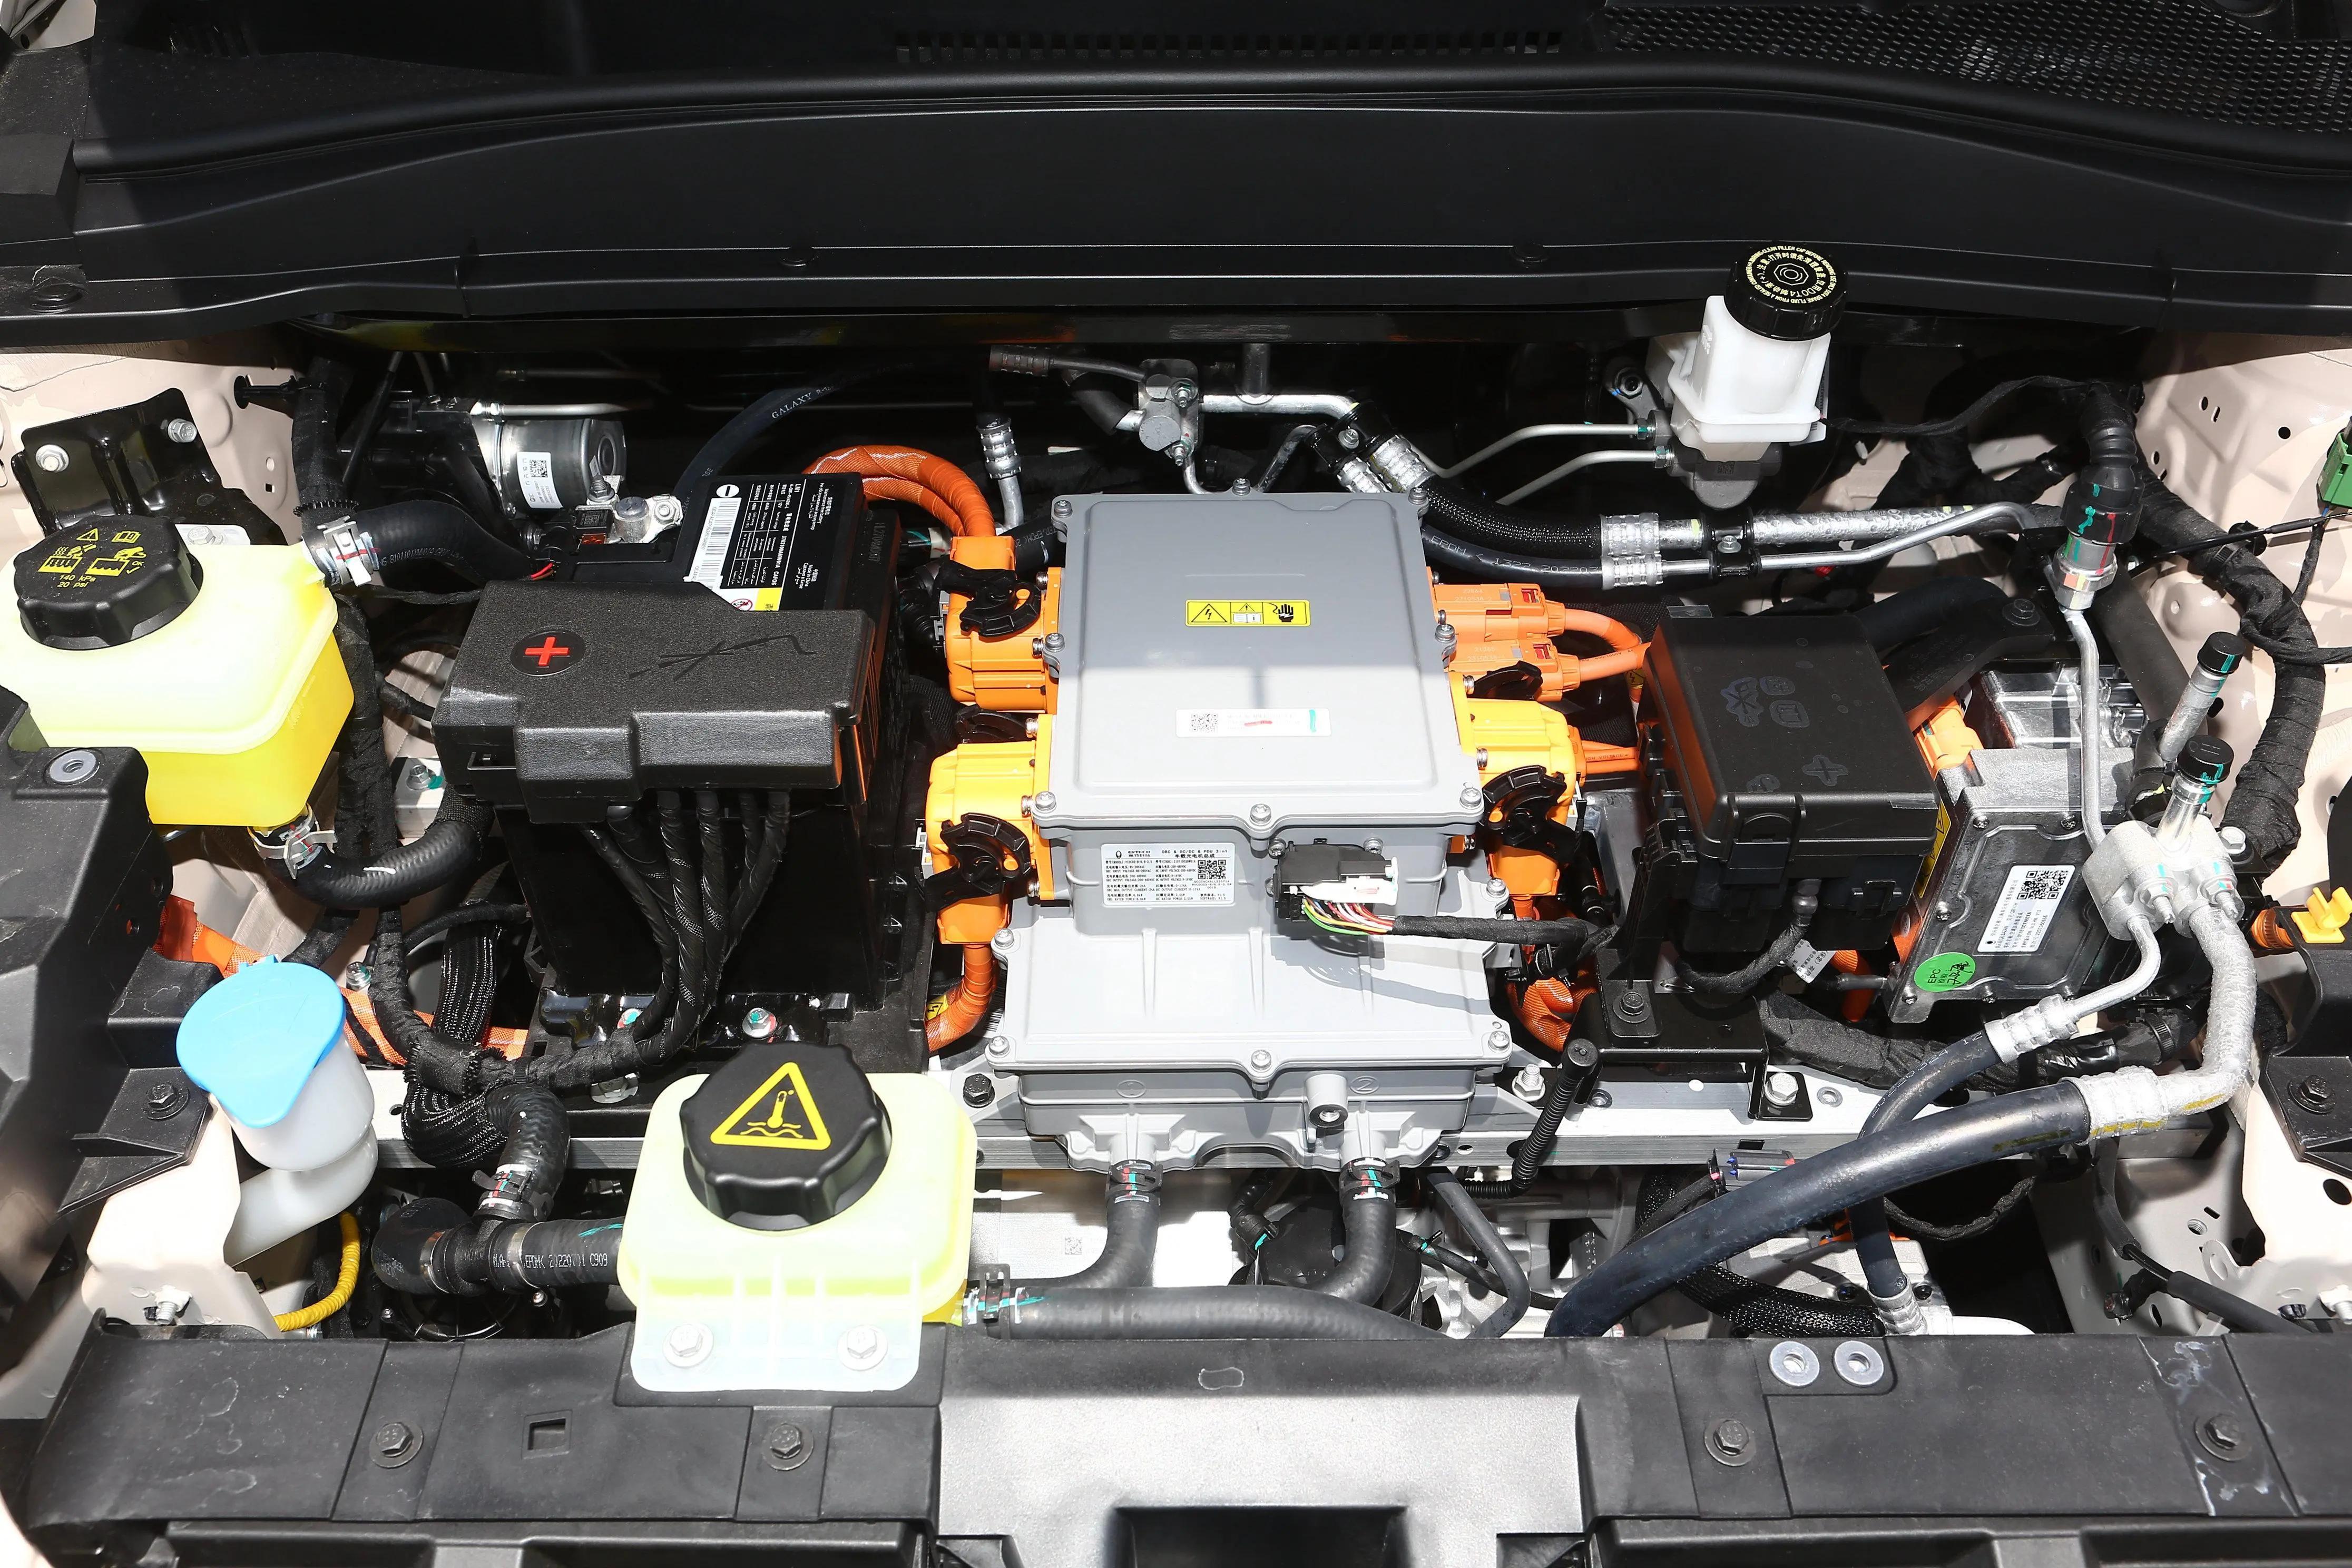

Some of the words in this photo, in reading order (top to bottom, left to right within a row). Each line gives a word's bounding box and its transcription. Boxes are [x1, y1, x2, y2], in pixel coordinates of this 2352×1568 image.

[771, 391, 812, 419] GALAXY
[770, 571, 779, 585] CAFOS
[1927, 968, 1941, 984] EPC
[1358, 1079, 1374, 1092] 2
[589, 1252, 608, 1267] C909
